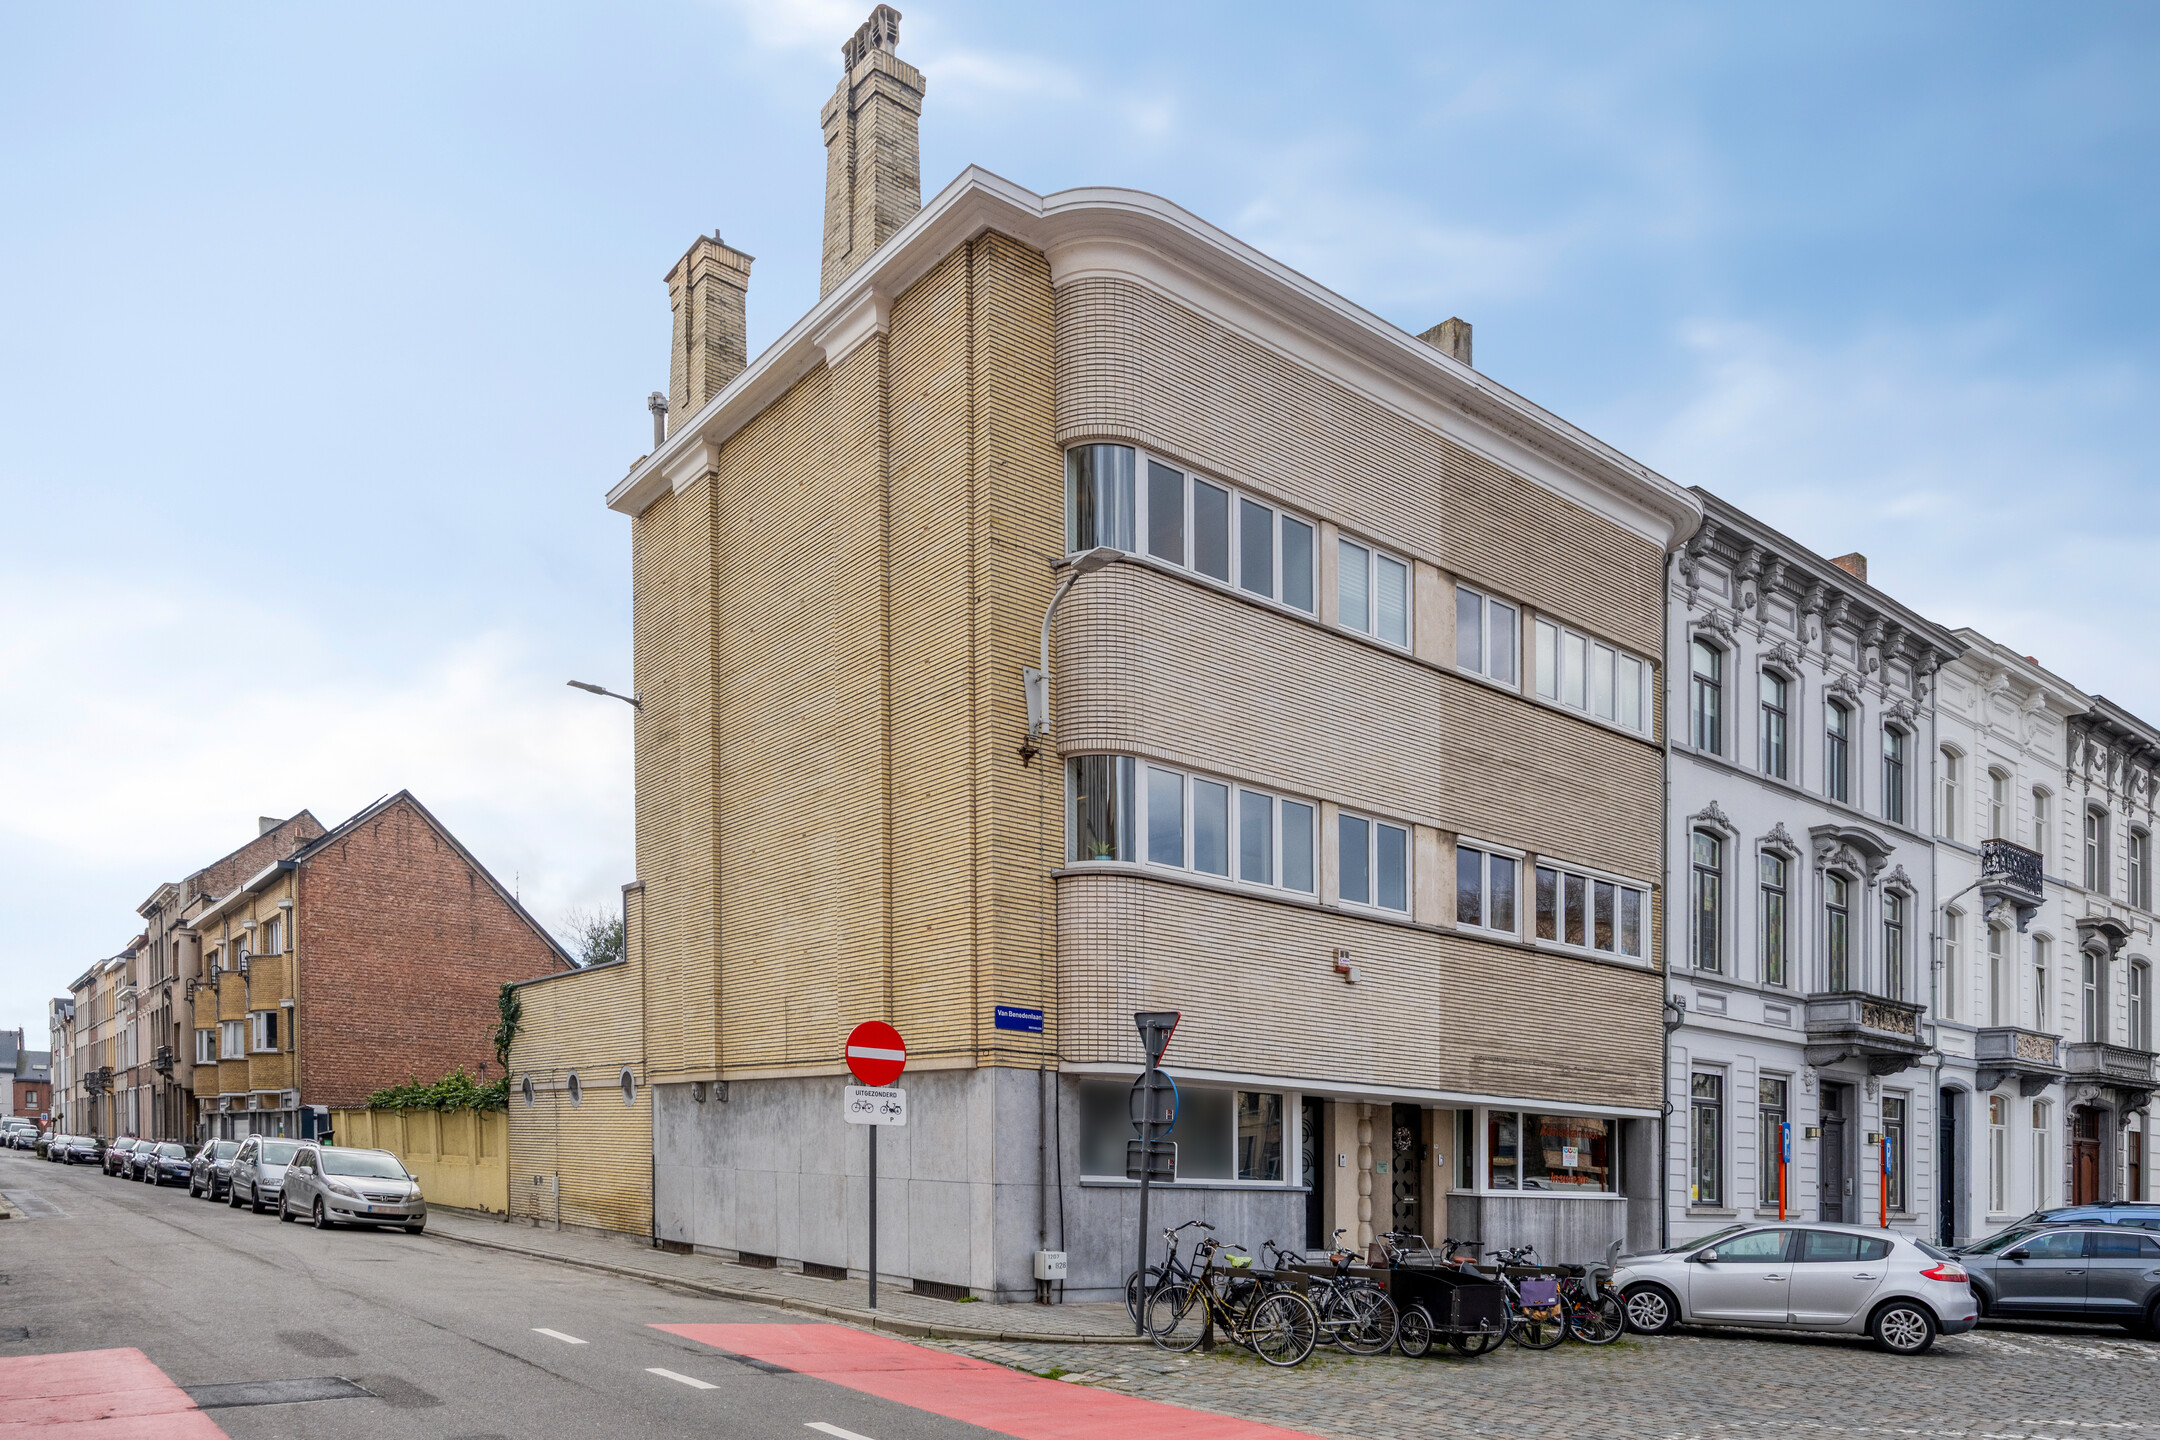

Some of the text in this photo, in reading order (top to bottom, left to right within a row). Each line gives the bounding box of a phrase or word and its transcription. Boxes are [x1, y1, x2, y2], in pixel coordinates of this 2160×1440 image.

[997, 1009, 1042, 1020] Van Benedenlaan
[855, 1090, 897, 1098] UITGEZONDERD
